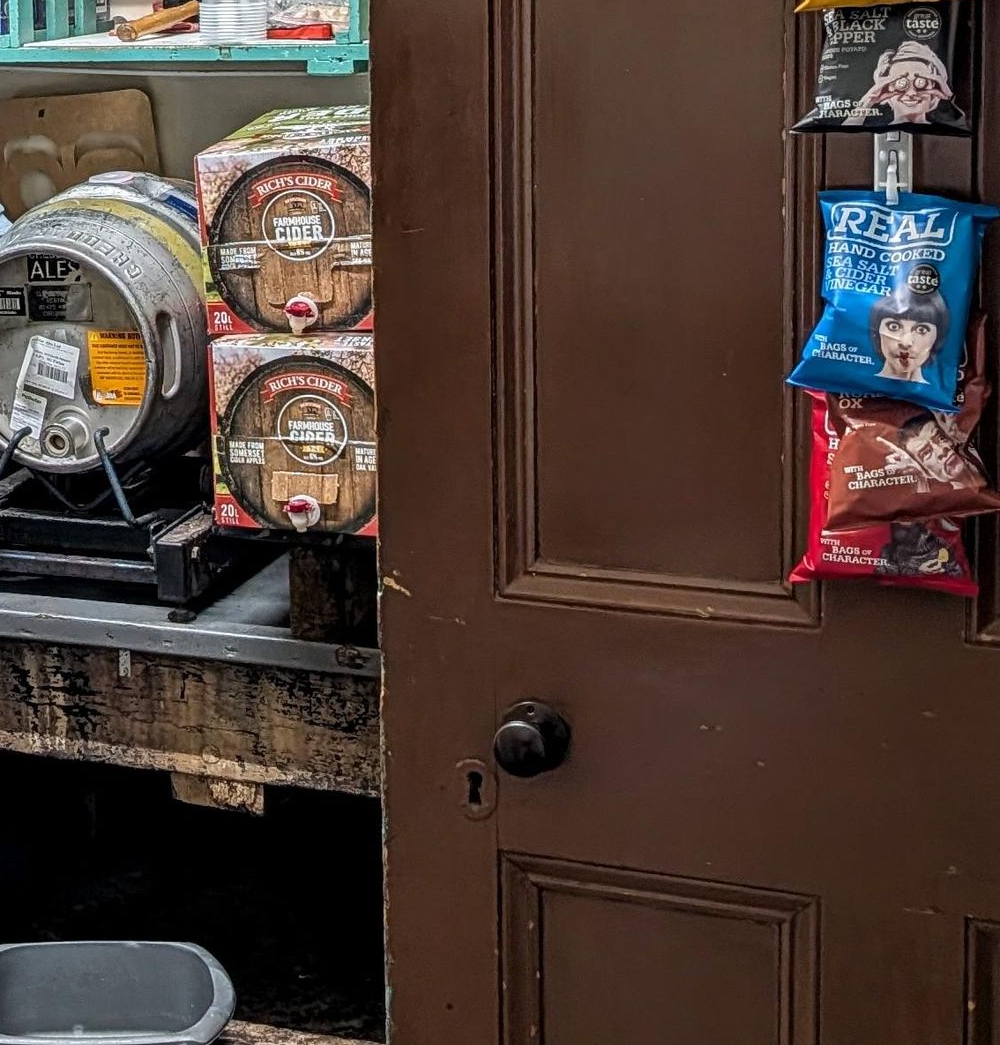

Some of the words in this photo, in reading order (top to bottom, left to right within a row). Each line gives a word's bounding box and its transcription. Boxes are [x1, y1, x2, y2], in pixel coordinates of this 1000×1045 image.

[832, 19, 886, 33] BLACK
[906, 18, 939, 29] taste
[824, 100, 851, 110] BAGS
[256, 175, 294, 196] RICH'S
[295, 175, 333, 192] CIDER
[273, 215, 321, 227] FARMHOUSE
[834, 207, 946, 243] REAL
[275, 225, 324, 243] CIDER
[828, 242, 876, 259] HAND
[880, 248, 946, 263] COOKED
[826, 255, 853, 268] SEA
[857, 259, 900, 276] SALT
[835, 267, 887, 286] CIDER
[825, 278, 892, 297] VINEGAR
[214, 311, 232, 324] 20L
[215, 323, 233, 332] STILL
[820, 342, 847, 352] BAGS
[269, 375, 304, 393] RICH'S
[306, 375, 342, 394] CIDER
[839, 399, 863, 410] OX
[288, 420, 335, 432] FARMHOUSE
[290, 430, 336, 444] CIDER
[229, 449, 265, 457] SOMERSET
[857, 469, 884, 480] BAGS
[848, 475, 918, 490] CHARACTER.
[221, 504, 239, 517] 20L
[221, 517, 239, 526] STILL
[820, 538, 840, 546] WITH
[832, 546, 860, 555] BAGS
[822, 553, 890, 567] CHARACTER.
